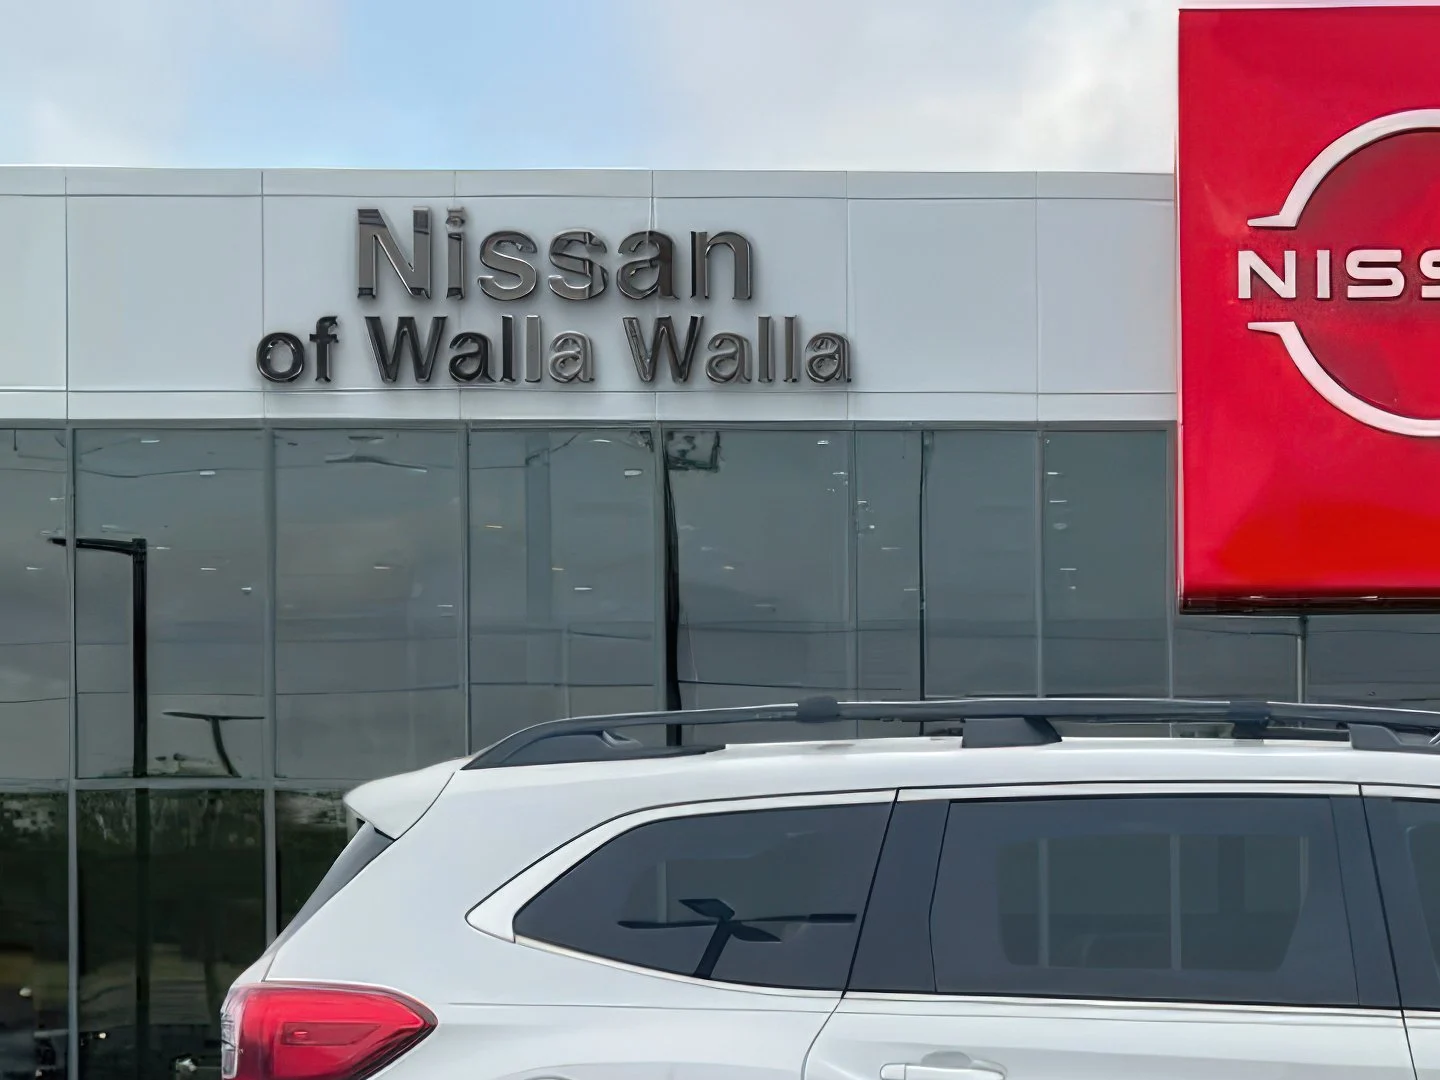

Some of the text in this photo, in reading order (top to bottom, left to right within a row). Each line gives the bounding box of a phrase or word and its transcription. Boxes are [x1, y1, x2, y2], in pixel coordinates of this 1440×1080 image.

[355, 205, 754, 301] Nissan
[255, 314, 853, 385] of Walla Walla
